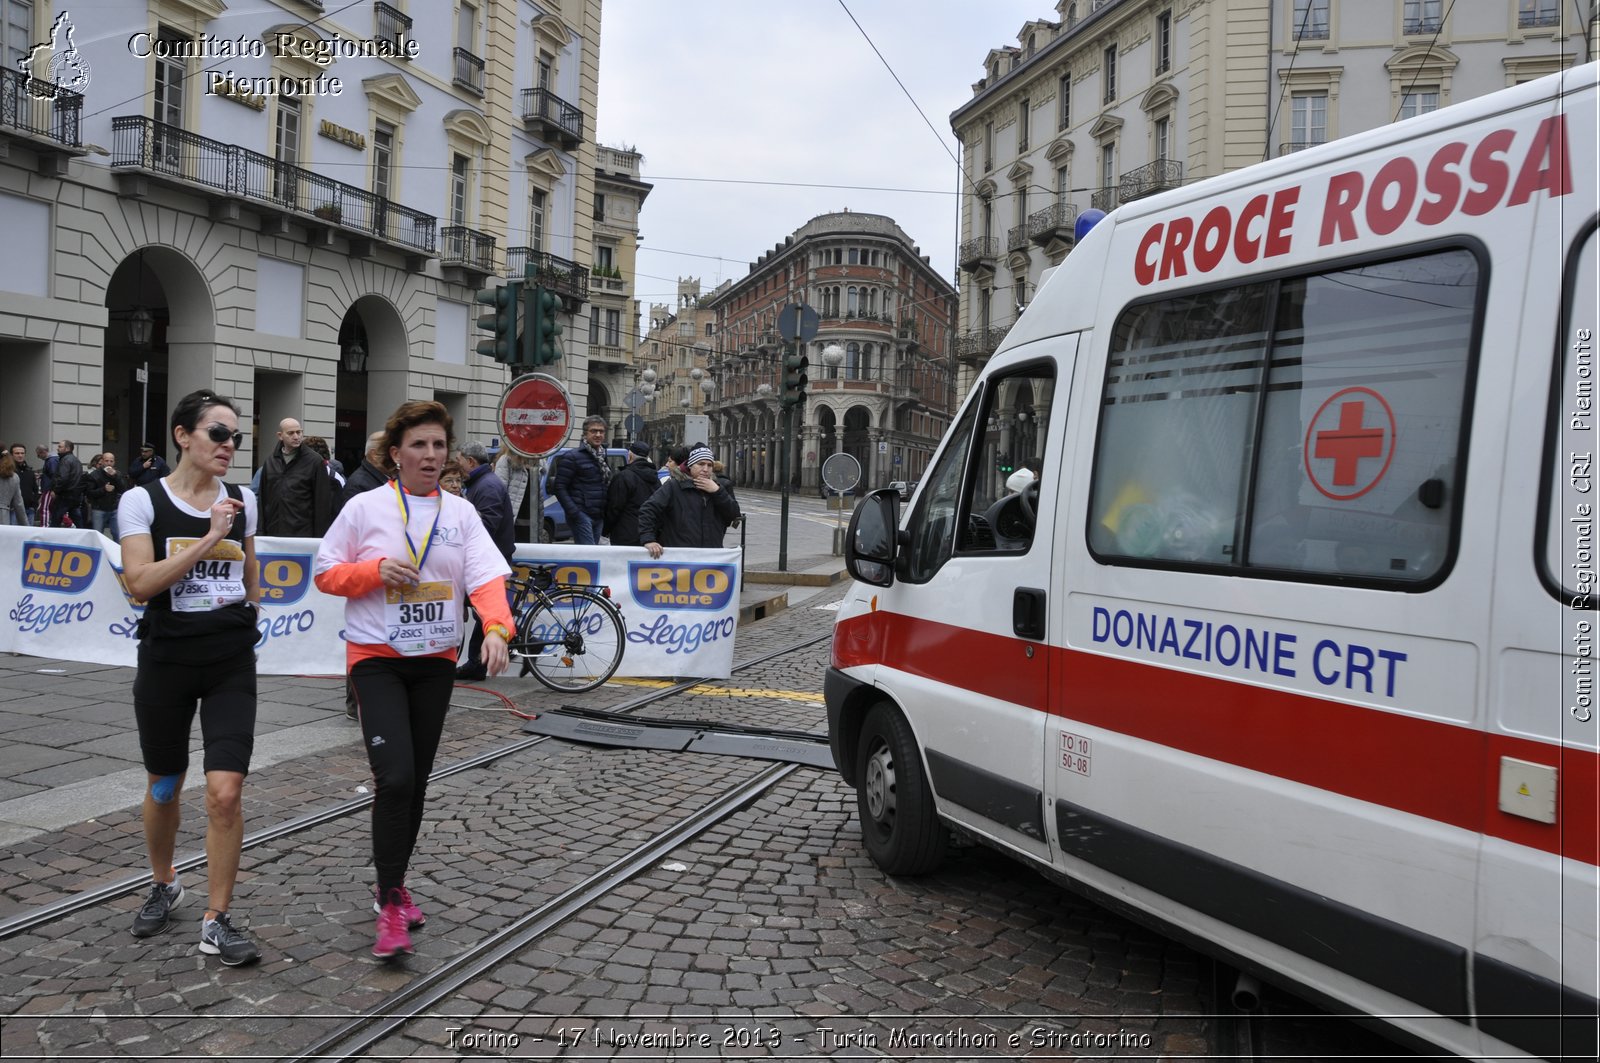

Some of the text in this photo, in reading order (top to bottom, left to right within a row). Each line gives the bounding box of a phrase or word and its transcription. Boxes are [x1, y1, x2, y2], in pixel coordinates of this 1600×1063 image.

[1134, 113, 1574, 286] CROCE ROSSA
[25, 548, 93, 577] RIO
[28, 573, 72, 587] mare
[215, 584, 241, 594] Unipol
[638, 568, 728, 593] RIO
[654, 593, 712, 605] mare
[10, 593, 94, 633] Leggero
[400, 602, 444, 623] 3507
[430, 624, 454, 636] Unipol
[627, 614, 734, 654] Leggero
[1092, 606, 1407, 698] DONAZIONE CRT
[1062, 734, 1088, 754] TO 10
